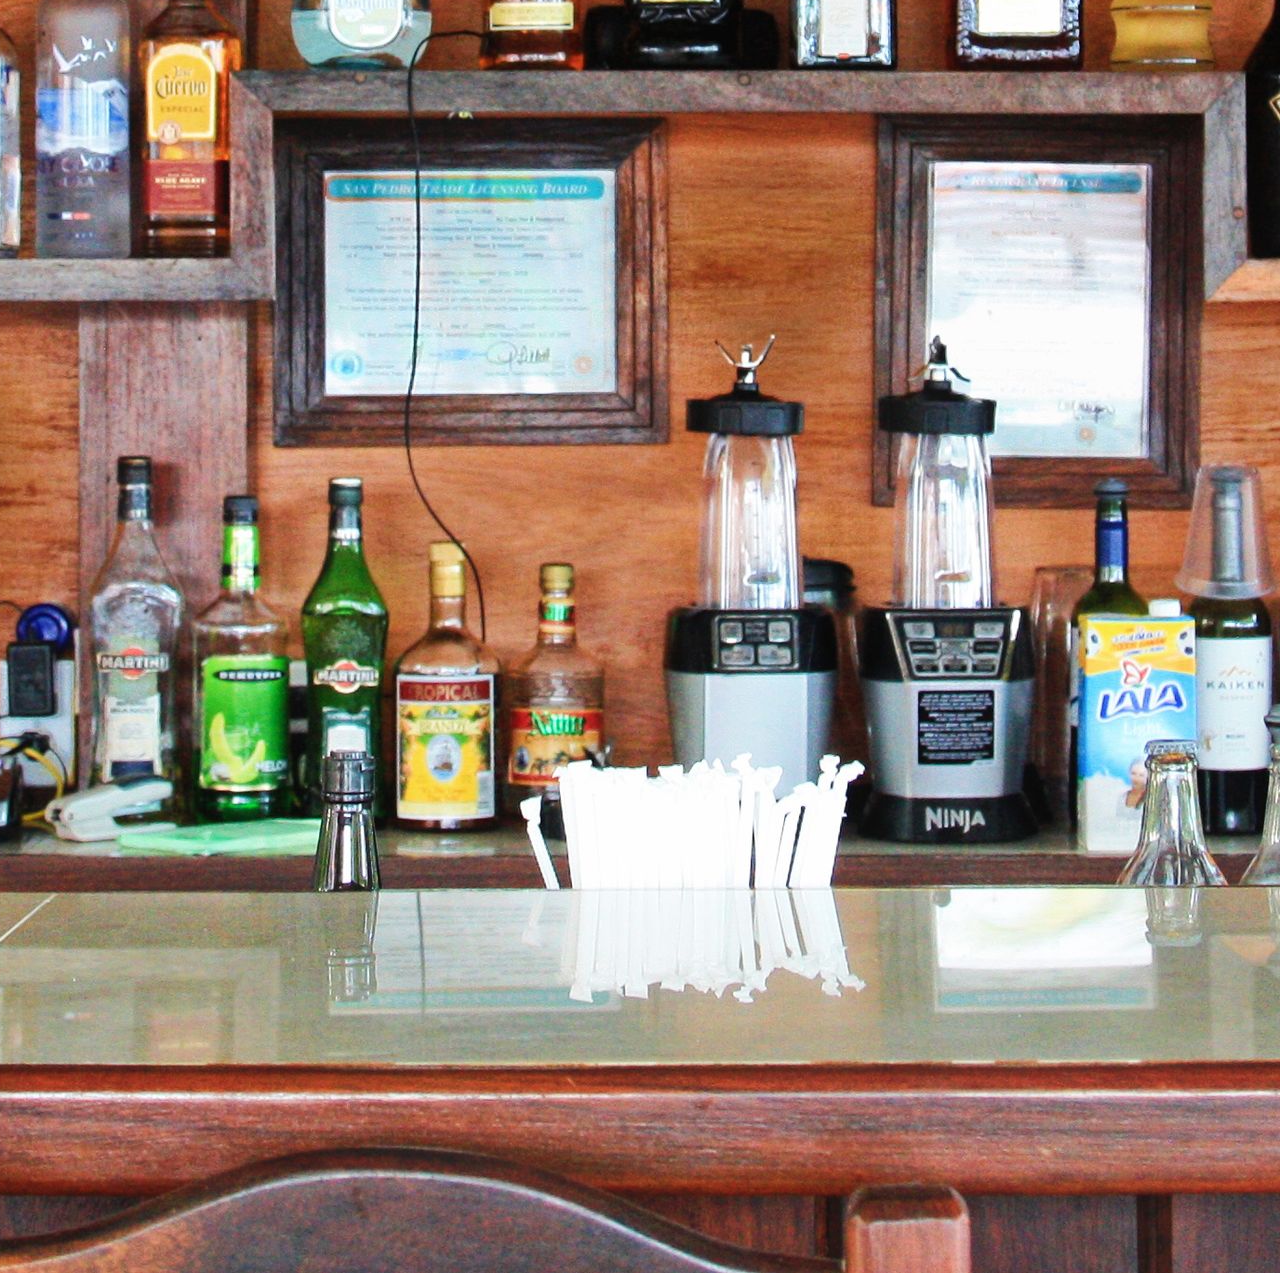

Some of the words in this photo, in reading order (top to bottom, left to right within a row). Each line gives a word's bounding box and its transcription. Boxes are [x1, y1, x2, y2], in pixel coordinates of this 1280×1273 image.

[155, 75, 207, 99] Cuervo
[160, 105, 205, 114] ESPECIAL
[342, 183, 368, 195] SAN
[371, 182, 416, 196] PEDRO
[422, 183, 465, 195] TRADE
[468, 182, 537, 196] LICENSING
[542, 182, 589, 196] BOARD
[101, 656, 166, 668] MARTINI
[317, 670, 377, 683] MARTINI
[1206, 680, 1265, 690] KAIKEN
[1100, 685, 1183, 720] LALA
[925, 805, 987, 833] NINJA
